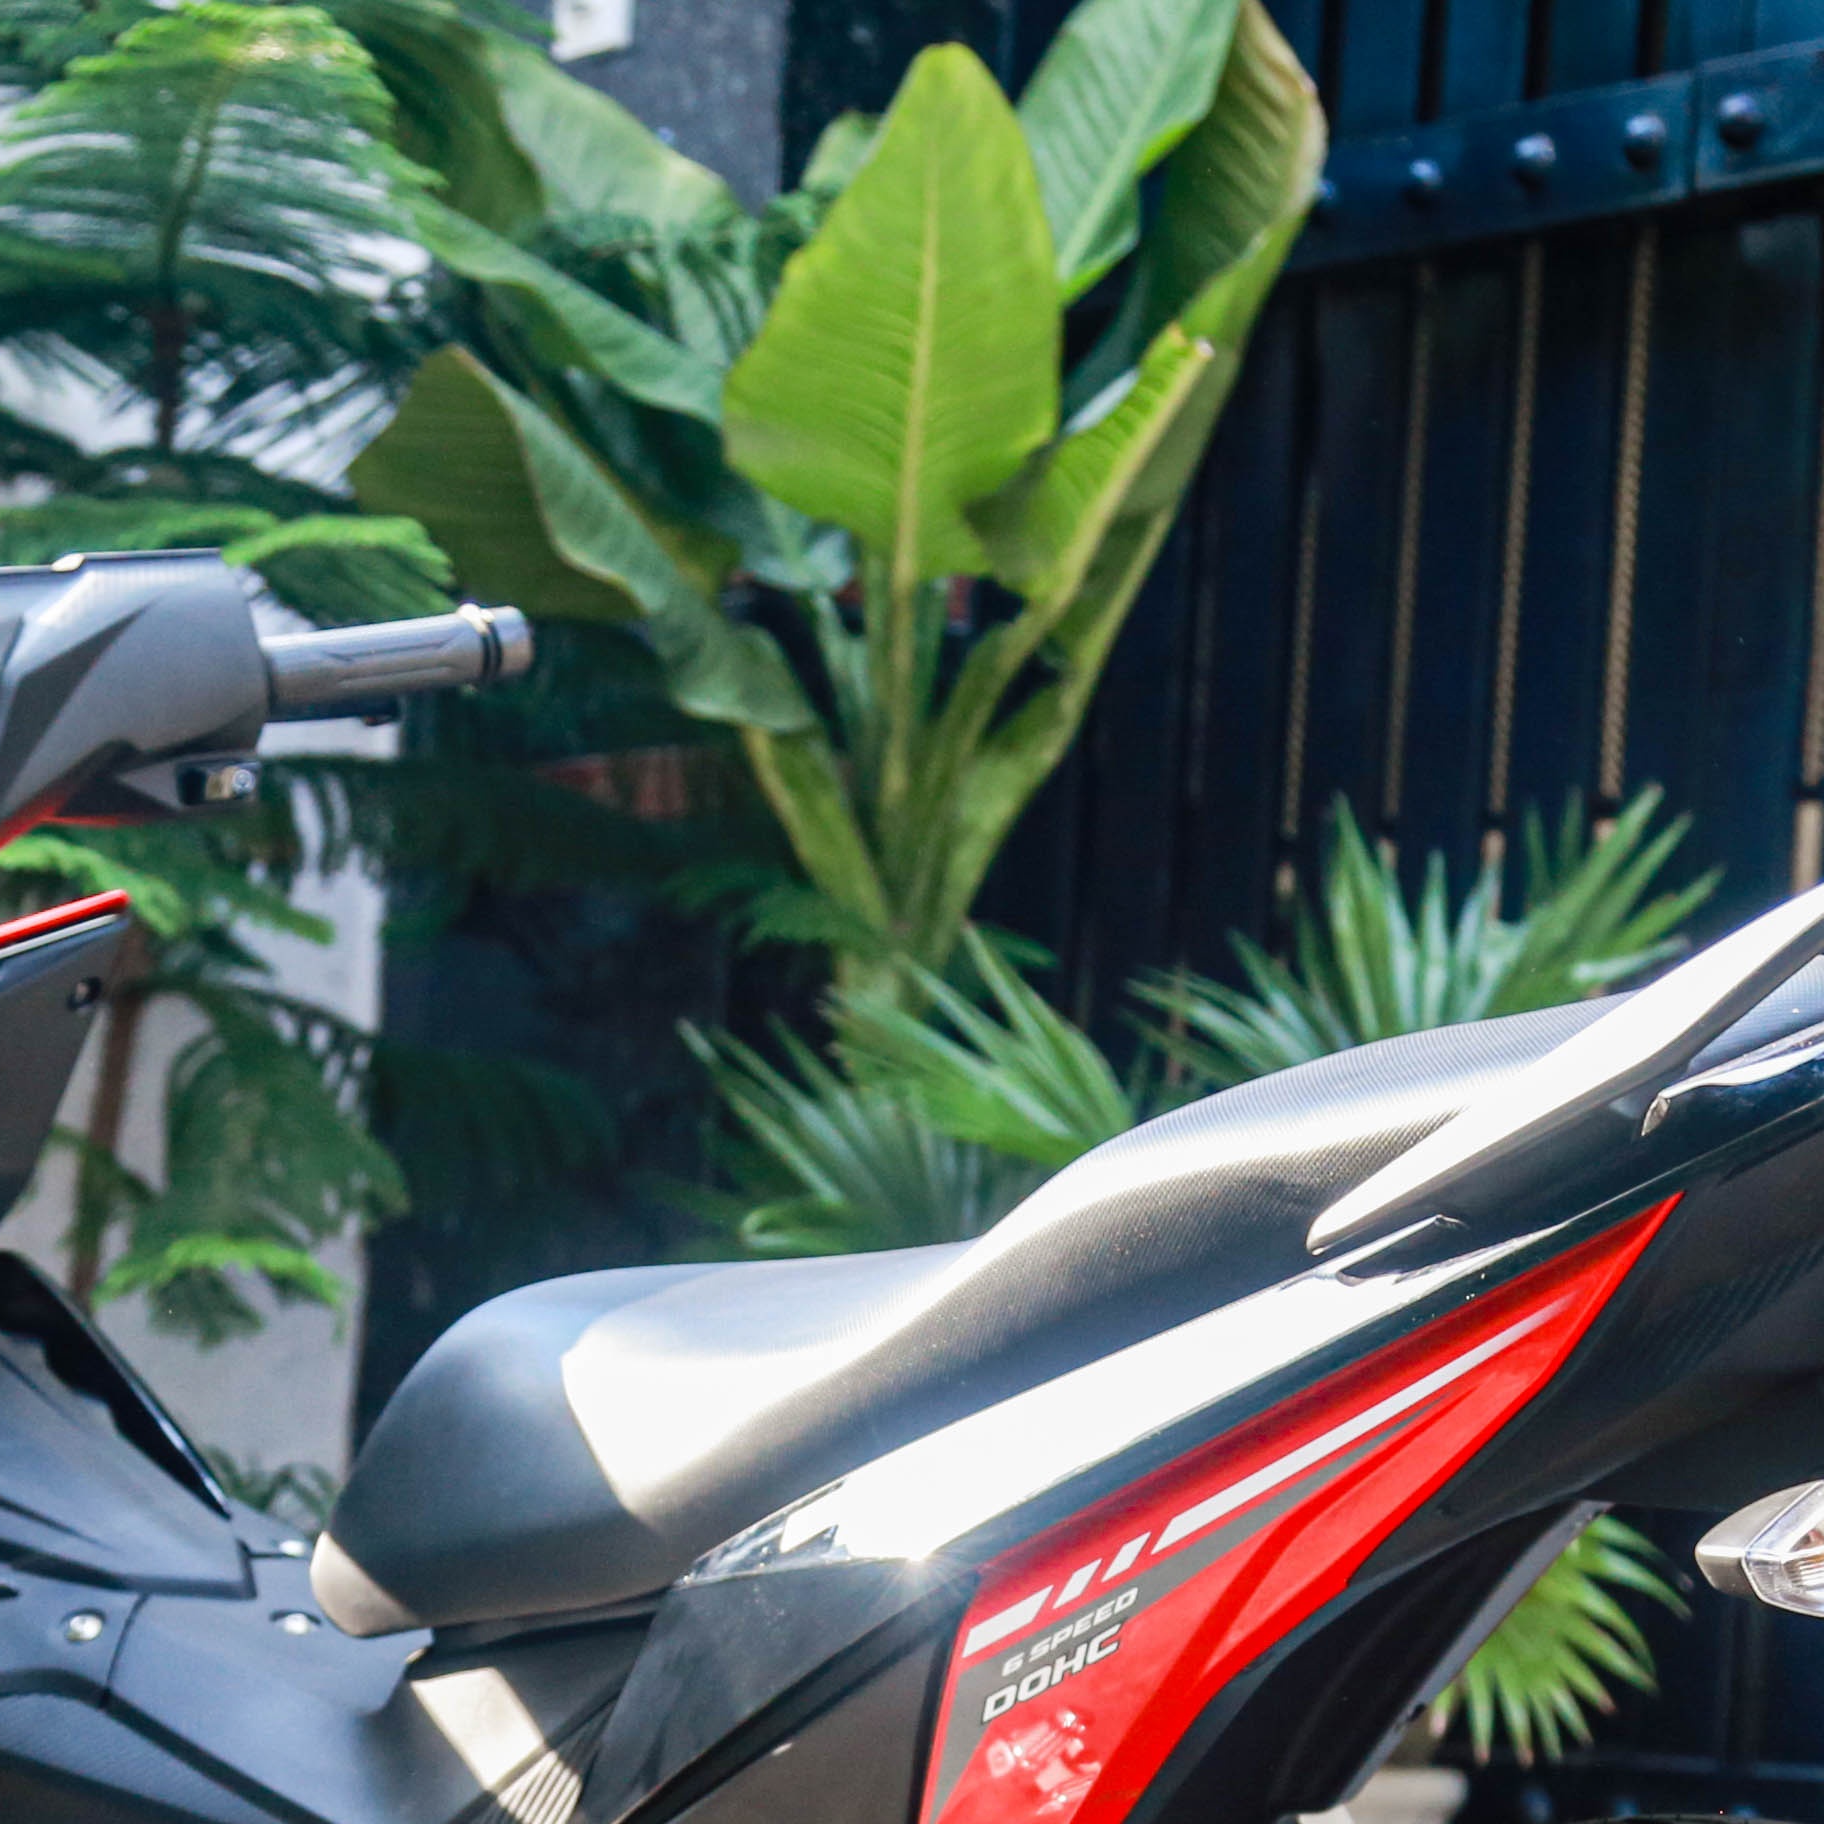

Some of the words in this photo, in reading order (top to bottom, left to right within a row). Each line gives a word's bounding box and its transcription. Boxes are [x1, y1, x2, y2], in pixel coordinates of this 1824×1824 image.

[982, 1622, 1124, 1725] DOHC
[1001, 1652, 1026, 1677] 6
[1029, 1587, 1139, 1663] SPEED
